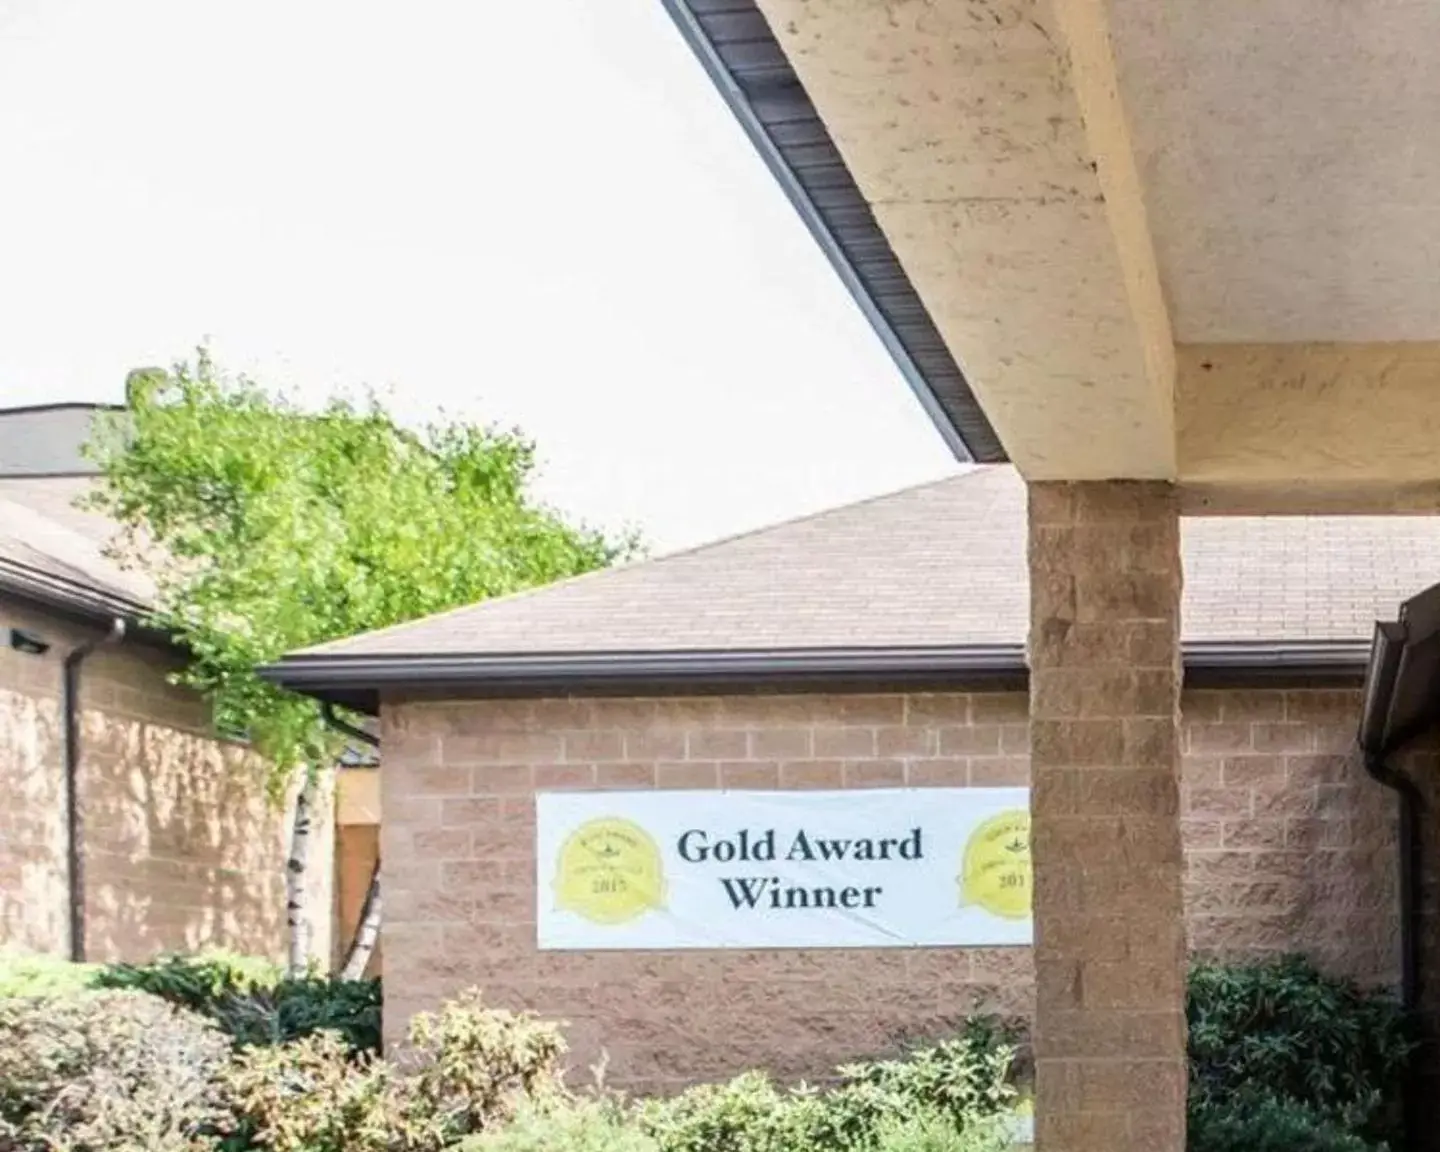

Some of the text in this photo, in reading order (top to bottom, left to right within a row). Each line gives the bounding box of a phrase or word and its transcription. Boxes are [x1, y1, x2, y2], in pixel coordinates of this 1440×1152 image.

[677, 829, 776, 863] Gold
[785, 827, 924, 861] Award
[719, 876, 883, 910] Winner
[998, 873, 1026, 889] 201
